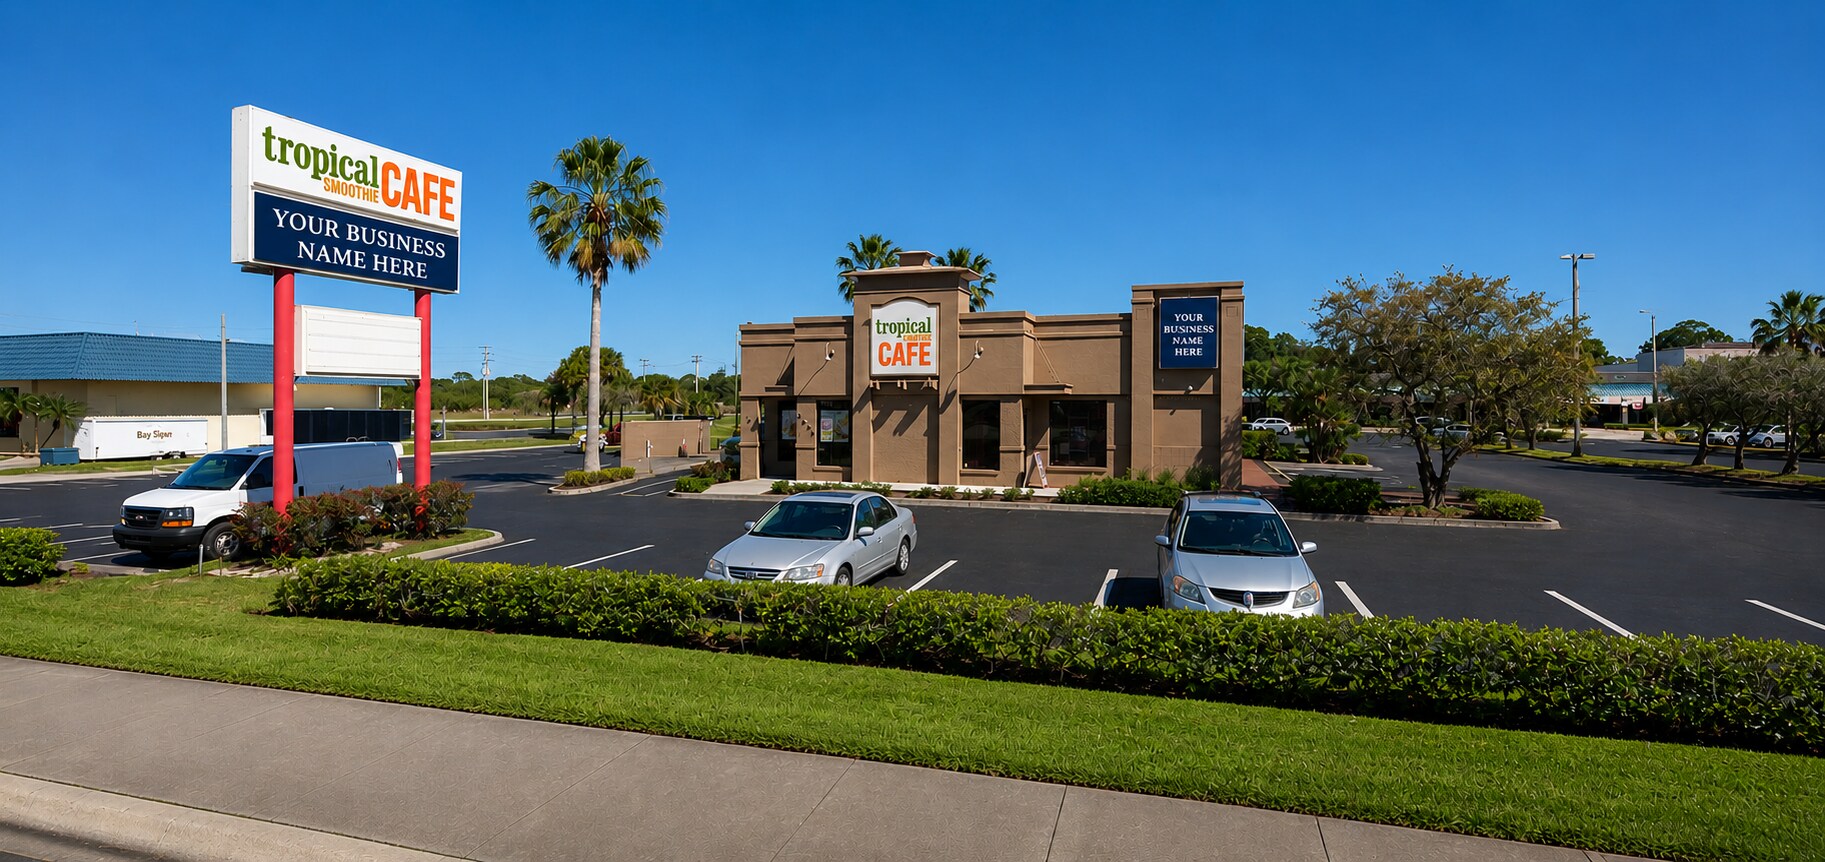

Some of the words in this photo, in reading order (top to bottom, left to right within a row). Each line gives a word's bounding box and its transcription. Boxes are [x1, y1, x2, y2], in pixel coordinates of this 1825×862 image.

[262, 126, 379, 188] tropical
[381, 161, 455, 222] CAFE
[323, 177, 379, 204] SMOOTHIE
[272, 207, 340, 239] YOUR
[346, 223, 446, 259] BUSINESS
[297, 240, 366, 269] NAME
[372, 254, 428, 279] HERE
[875, 317, 931, 338] tropical
[1174, 313, 1203, 322] YOUR
[1163, 325, 1214, 334] BUSINESS
[1172, 336, 1203, 345] NAME
[878, 341, 931, 367] CAFE
[1174, 348, 1203, 356] HERE
[136, 430, 151, 440] Bay
